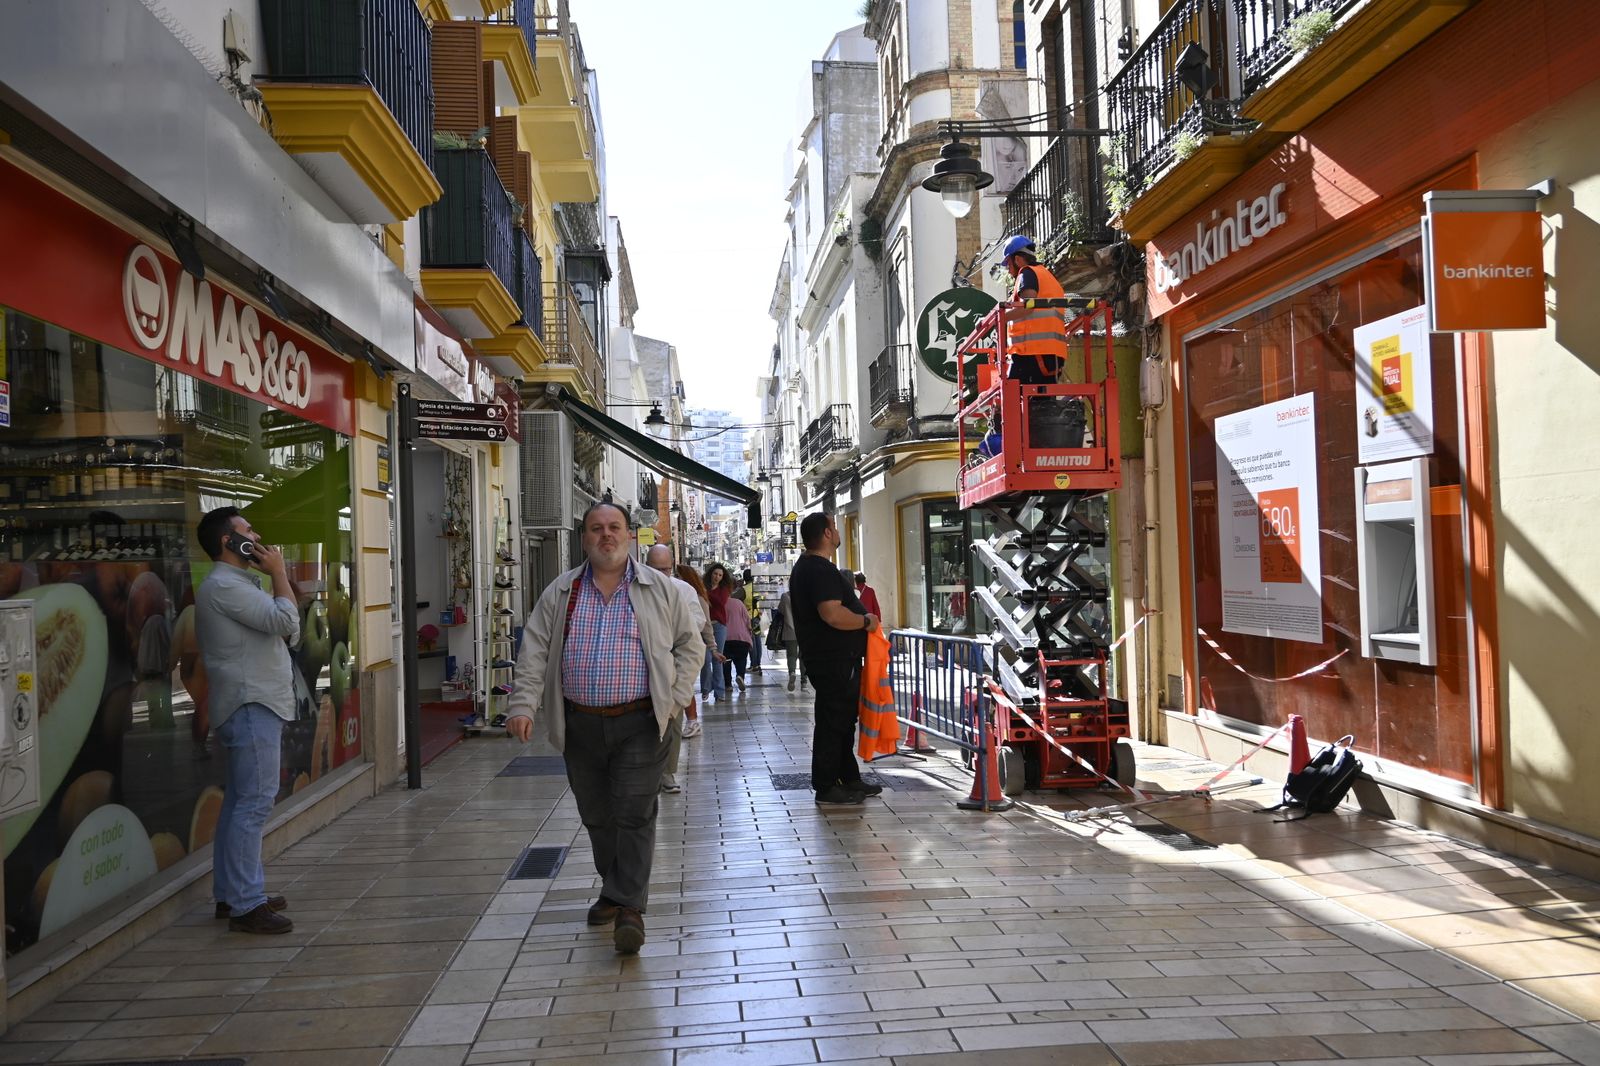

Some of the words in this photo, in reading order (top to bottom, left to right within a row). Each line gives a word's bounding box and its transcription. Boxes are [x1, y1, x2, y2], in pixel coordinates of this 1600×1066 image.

[419, 403, 436, 411] Iglesia
[450, 405, 475, 413] Milagrosa
[420, 423, 440, 431] Antigua
[1035, 455, 1091, 467] MANITOU
[80, 834, 99, 856] con
[102, 819, 124, 847] todo
[83, 862, 93, 887] el
[95, 852, 123, 881] sabor
